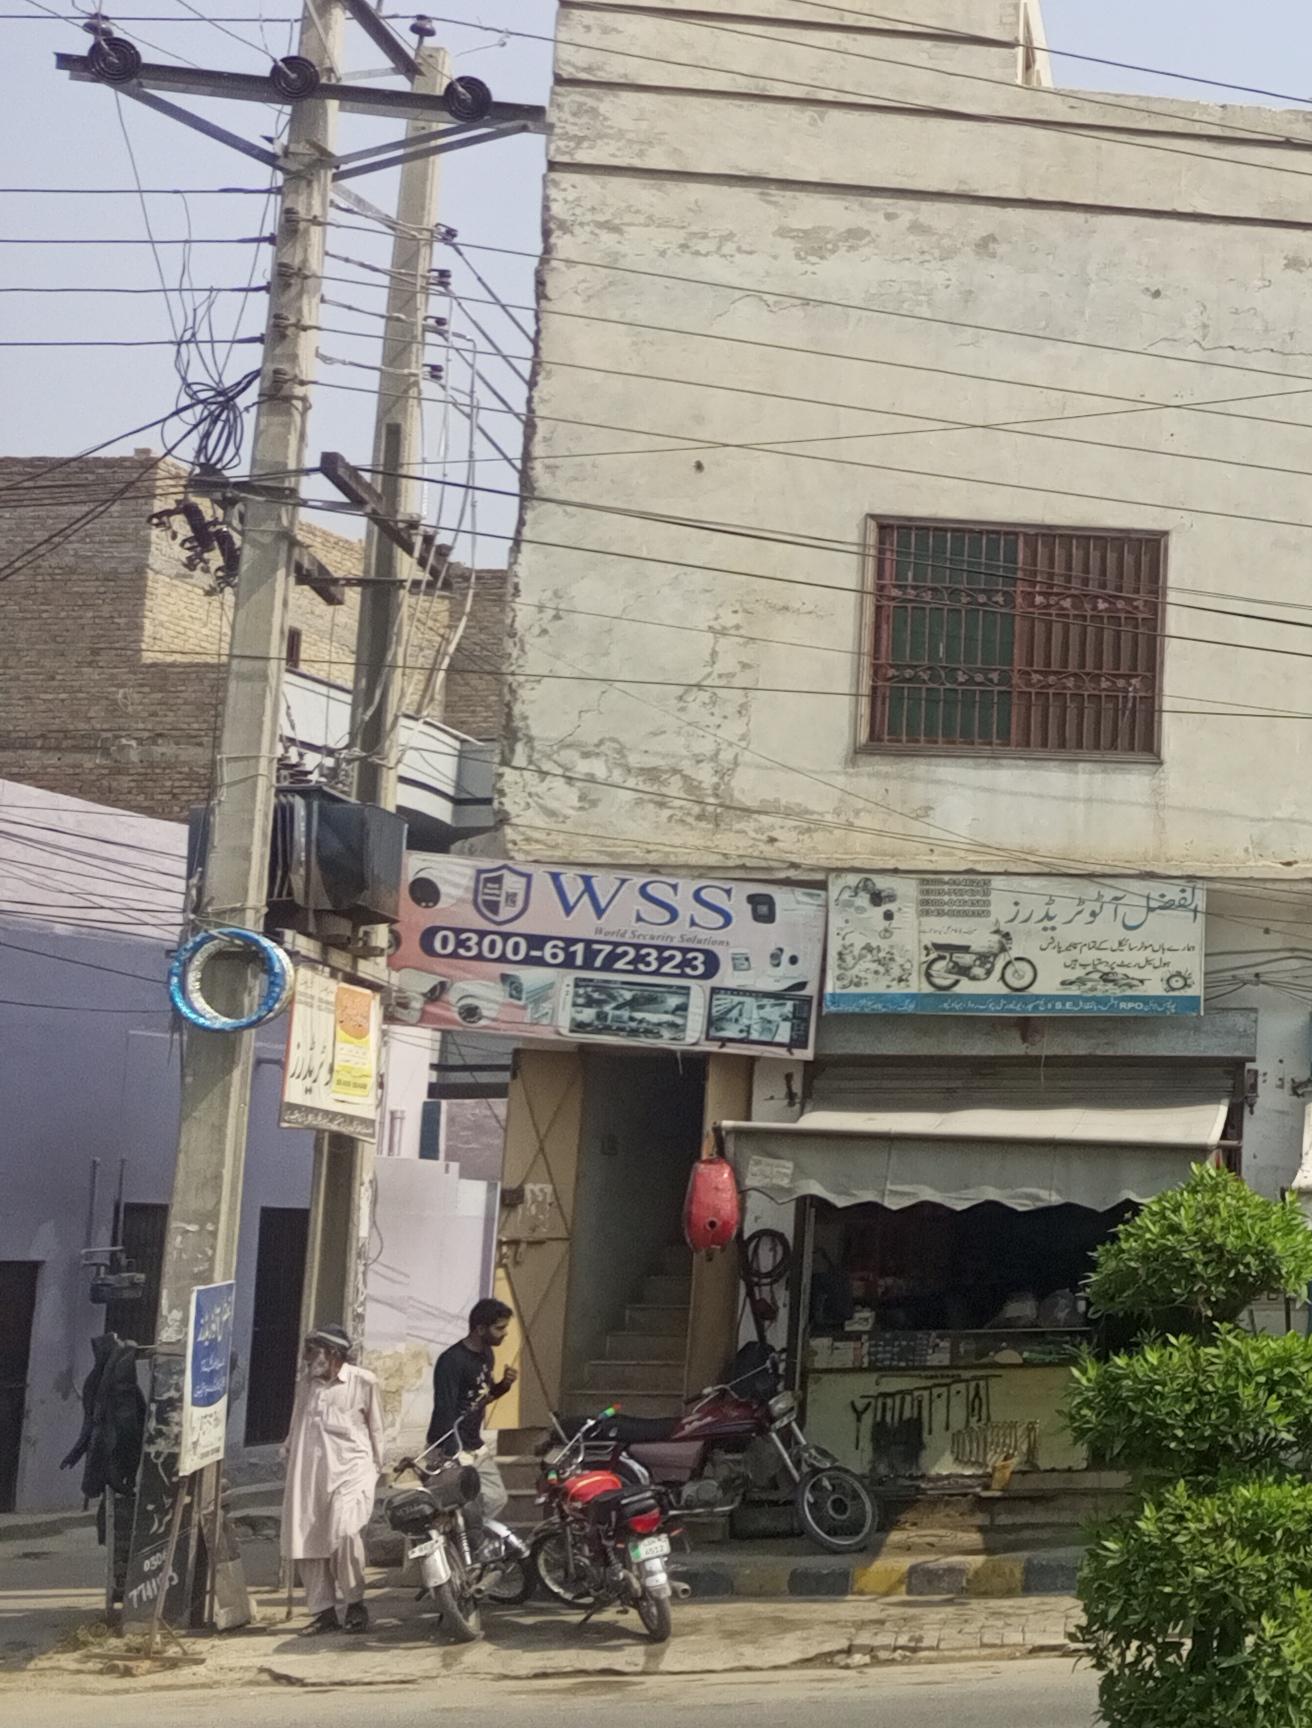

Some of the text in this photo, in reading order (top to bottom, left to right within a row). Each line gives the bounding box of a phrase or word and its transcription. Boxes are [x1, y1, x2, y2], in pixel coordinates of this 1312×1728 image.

[544, 871, 734, 931] WSS
[1122, 885, 1198, 931] الفضل
[433, 929, 706, 976] 0300-6172323
[594, 926, 730, 947] World Security Solutions
